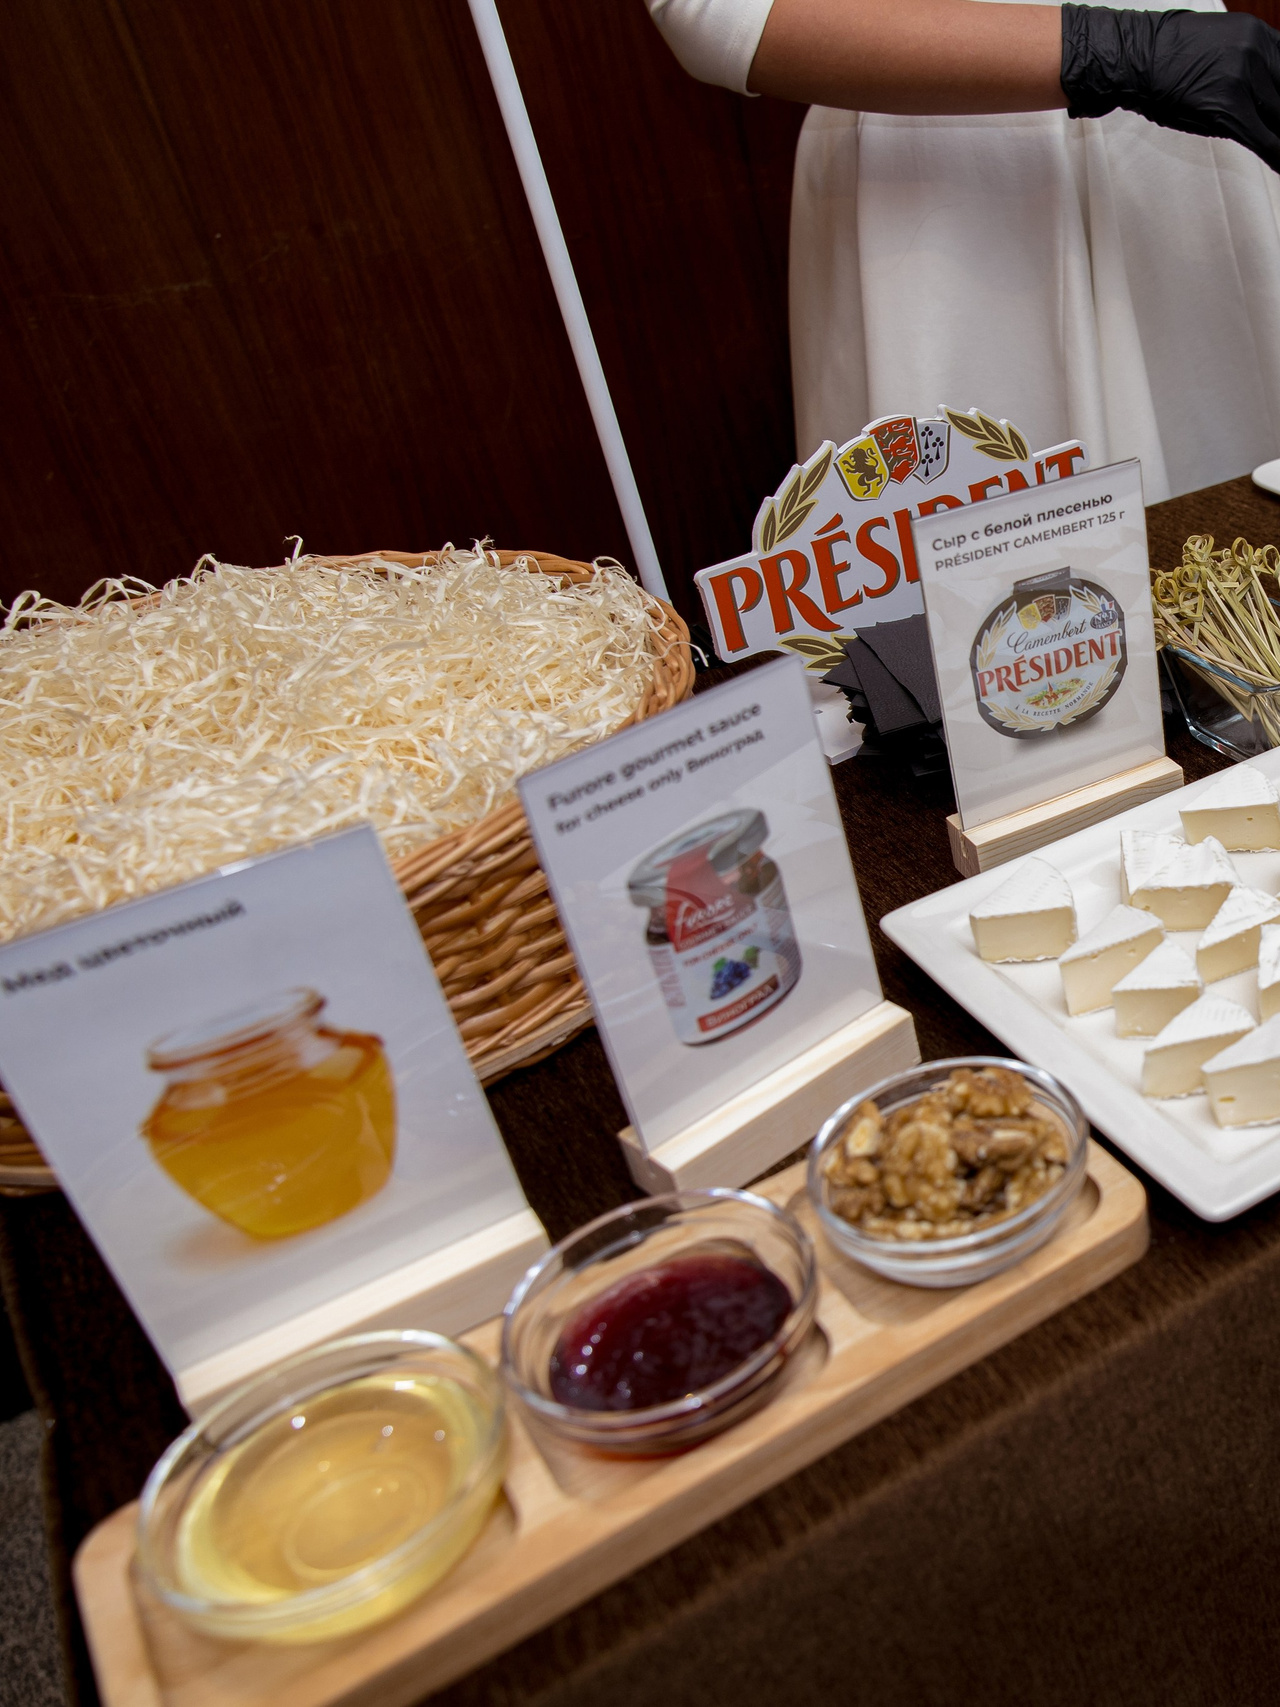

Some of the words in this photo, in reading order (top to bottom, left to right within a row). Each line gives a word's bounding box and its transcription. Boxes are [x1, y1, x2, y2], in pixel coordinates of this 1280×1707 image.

[932, 534, 967, 551] Сыр
[971, 530, 980, 540] с
[984, 514, 1033, 538] белой
[1037, 494, 1113, 523] плесенью
[935, 541, 1011, 571] PRÉSIDENT
[1013, 517, 1095, 549] CAMEMBERT
[1097, 511, 1117, 526] 125
[1119, 510, 1125, 519] г
[977, 630, 1122, 698] PRÉSIDENT
[1006, 618, 1087, 654] Camembert
[1033, 708, 1061, 717] RECETTE
[1064, 681, 1094, 710] NORMANDE
[547, 769, 617, 813] Furore
[620, 729, 704, 781] gourmet
[708, 702, 762, 738] sauce
[555, 816, 582, 836] for
[585, 786, 645, 822] cheese
[649, 766, 684, 793] only
[686, 729, 764, 773] Виноград
[0, 961, 76, 994] Мед
[77, 898, 246, 971] цветочный
